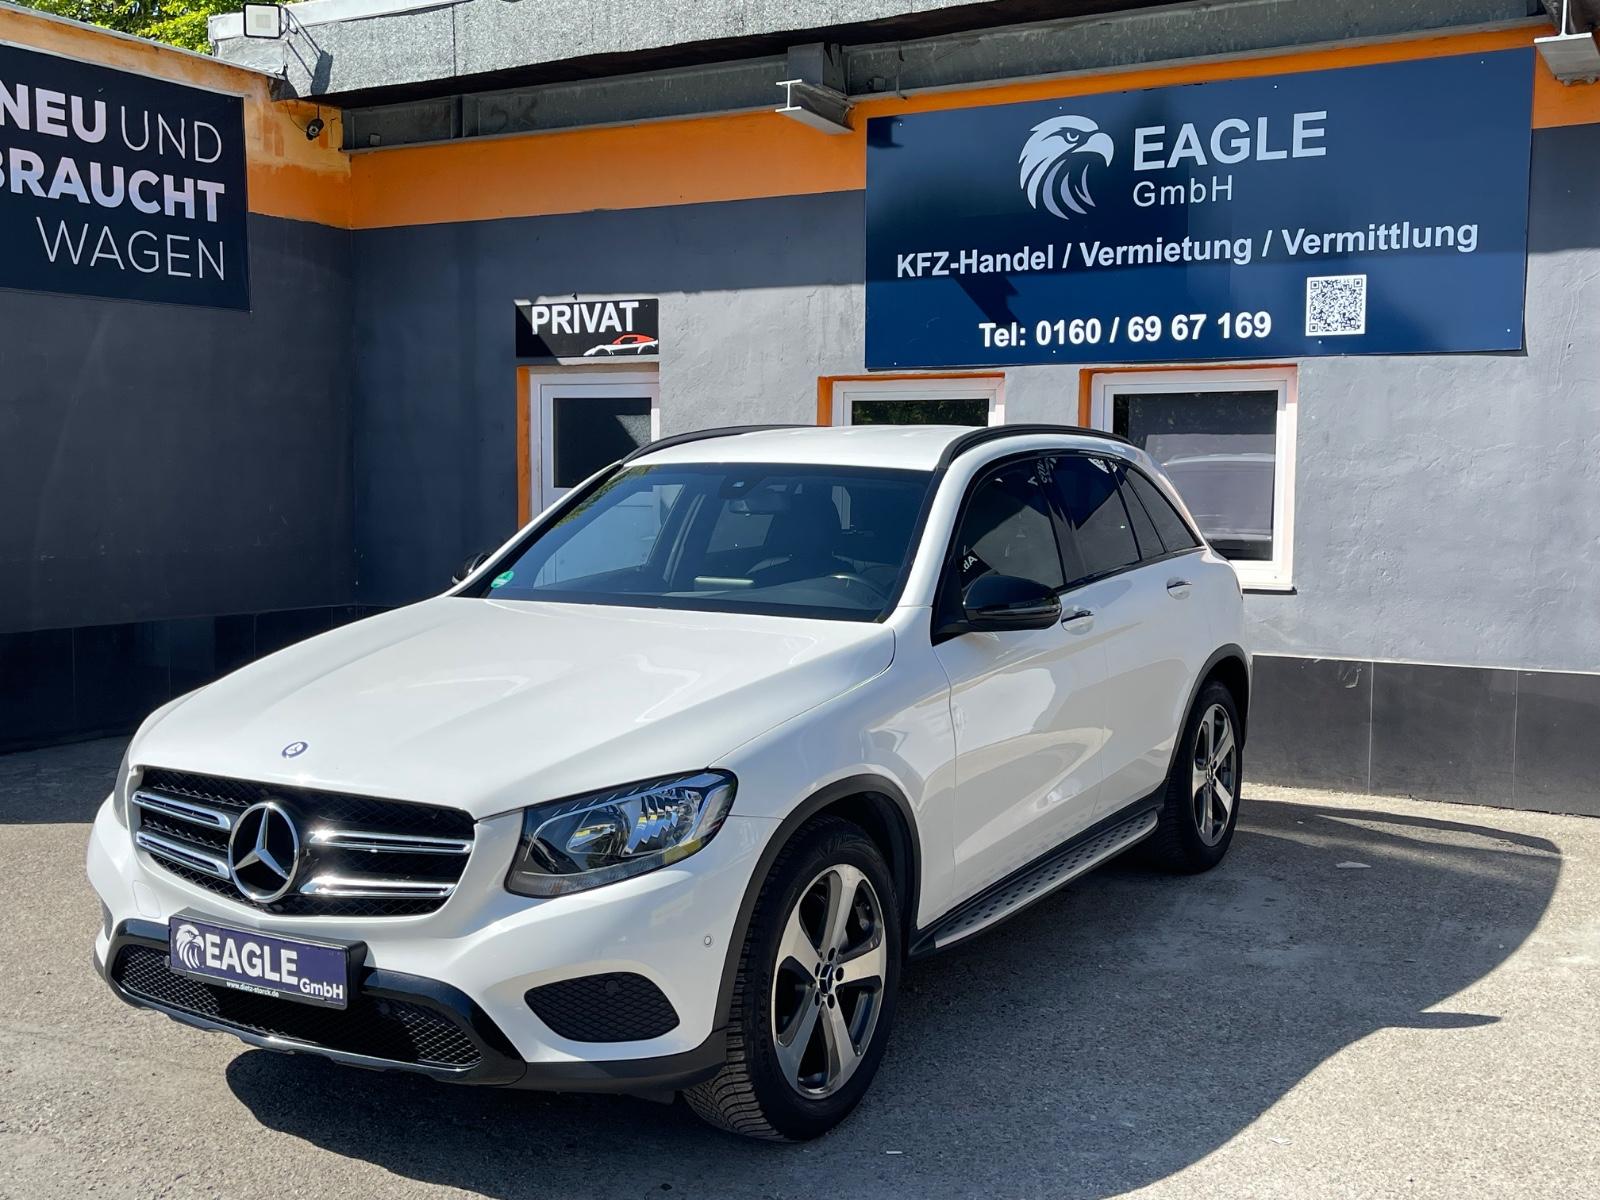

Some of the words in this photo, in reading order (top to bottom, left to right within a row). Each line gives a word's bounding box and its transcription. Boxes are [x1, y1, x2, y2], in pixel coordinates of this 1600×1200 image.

[0, 78, 106, 143] NEU
[121, 106, 222, 164] UND
[1133, 110, 1327, 171] EAGLE
[0, 148, 225, 222] RAUCHT
[1133, 174, 1233, 207] GmbH
[36, 216, 225, 281] WAGEN
[897, 244, 1054, 278] KFZ-Handel
[1062, 242, 1072, 269] /
[1079, 236, 1252, 267] Vermietung
[1261, 229, 1273, 257] /
[1281, 221, 1478, 255] Vermittlung
[532, 301, 640, 335] PRIVAT
[978, 321, 1026, 348] Tel:
[1035, 317, 1102, 346] 0160
[1109, 316, 1120, 344] /
[1127, 315, 1162, 343] 69
[1171, 313, 1207, 341] 67
[1217, 310, 1272, 339] 169
[205, 933, 298, 985] EAGLE
[300, 978, 343, 999] GmbH
